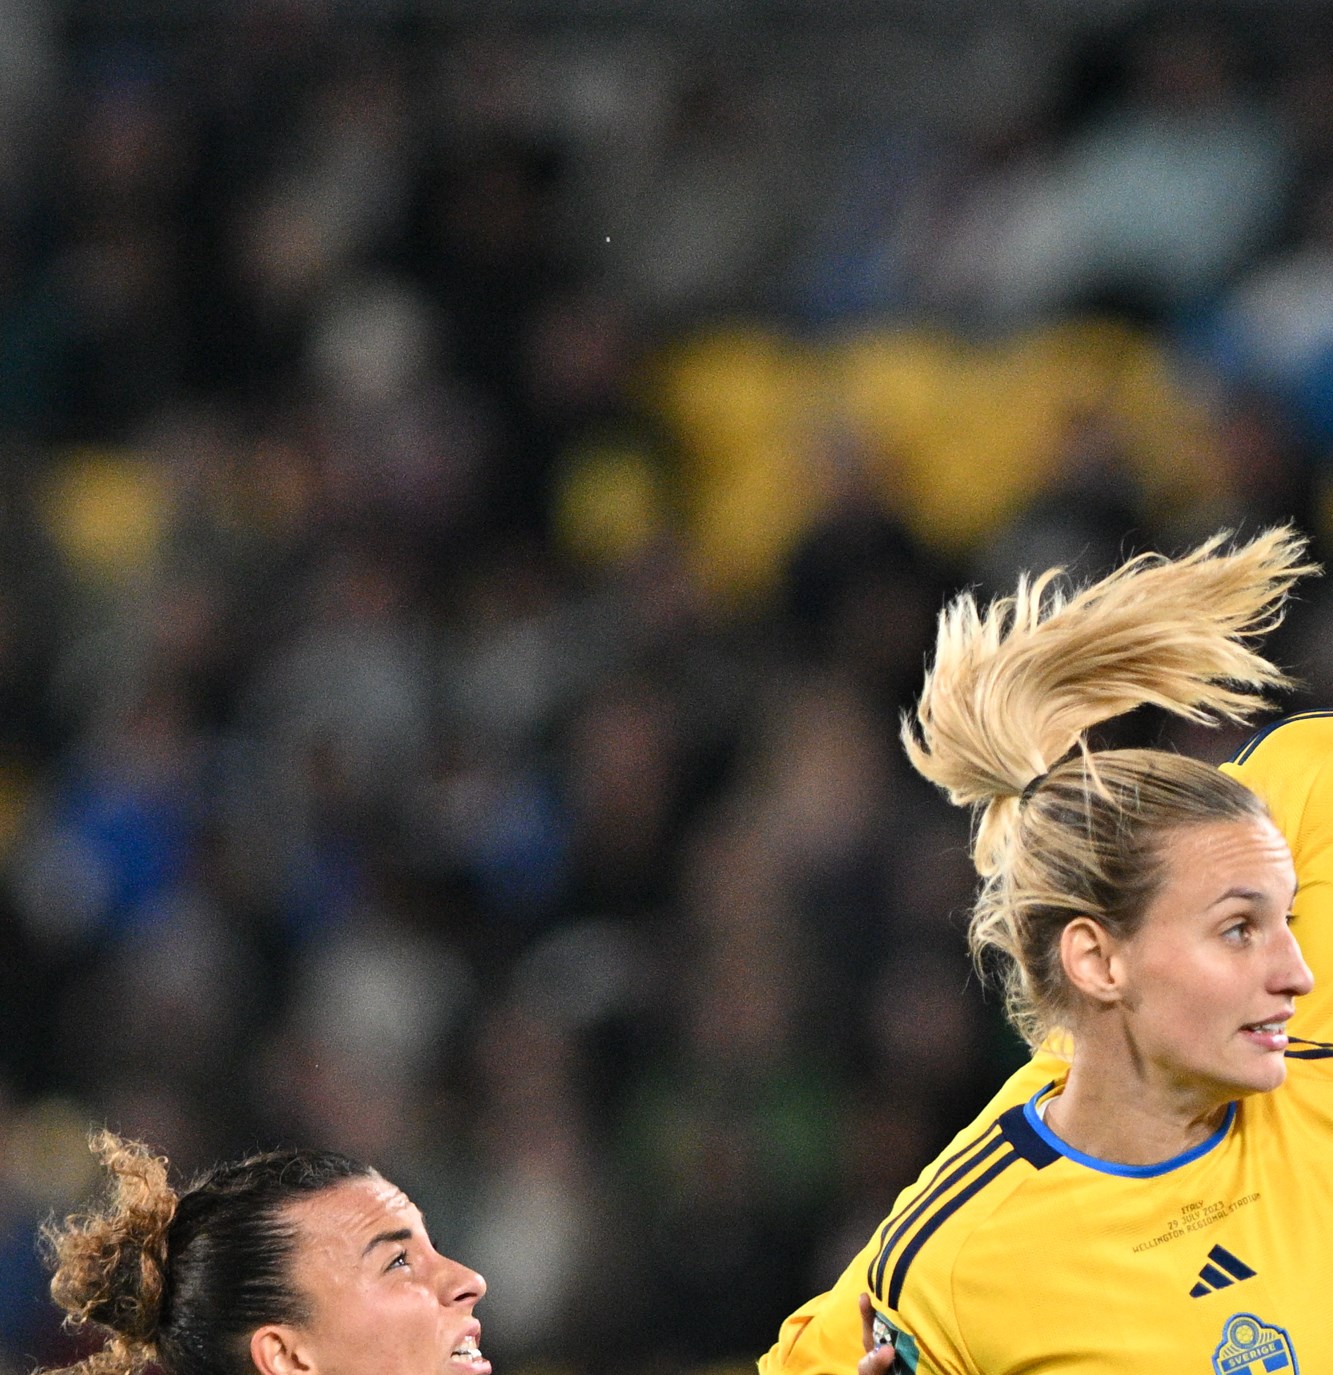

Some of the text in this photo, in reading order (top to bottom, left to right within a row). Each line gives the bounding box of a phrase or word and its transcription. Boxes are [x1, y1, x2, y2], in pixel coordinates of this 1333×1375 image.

[1181, 1200, 1204, 1215] ITALY
[1181, 1209, 1201, 1225] JULY
[1203, 1200, 1226, 1217] 2023
[1132, 1229, 1185, 1254] WELLINGTON
[1228, 1343, 1276, 1367] SVERIGE
